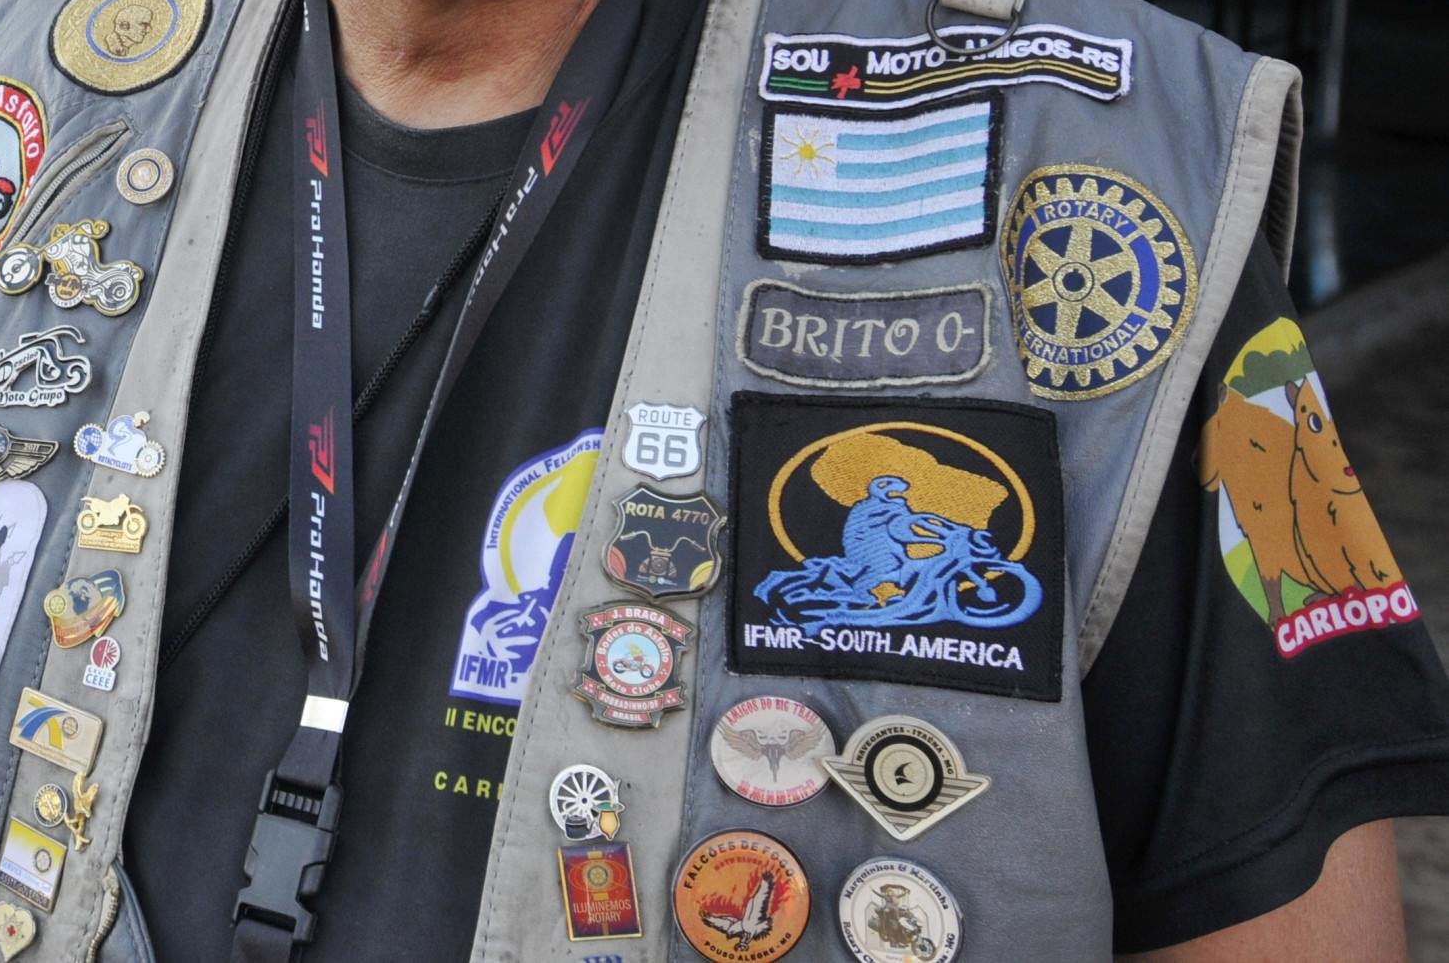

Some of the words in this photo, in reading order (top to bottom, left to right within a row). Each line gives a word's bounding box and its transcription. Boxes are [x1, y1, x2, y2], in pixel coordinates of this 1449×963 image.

[773, 48, 830, 73] SOU
[865, 46, 947, 76] MOTO
[1044, 201, 1129, 231] ROTARY
[759, 307, 920, 364] BRITO
[29, 389, 63, 405] Grupo
[638, 409, 693, 426] ROUTE
[544, 439, 601, 473] FELLOWSH
[636, 432, 688, 468] 66
[625, 501, 665, 520] ROTA
[671, 508, 710, 526] 4770
[612, 609, 623, 619] J.
[625, 608, 666, 625] BRAGA
[1277, 585, 1418, 654] CARLÓPO
[597, 624, 625, 655] Bodes
[627, 624, 642, 633] do
[645, 627, 670, 663] Asfalto
[901, 635, 1024, 671] AMERICA
[85, 673, 111, 689] CEEE
[603, 674, 627, 693] Moto
[632, 679, 663, 694] Clube
[462, 710, 517, 738] ENCO
[612, 711, 643, 722] BRASIL
[725, 699, 759, 726] AMIGOS
[792, 703, 819, 727] TRAIL
[856, 726, 905, 762] NAVEGANTES
[683, 840, 737, 890] FALCÕES
[741, 840, 759, 851] DE
[761, 845, 796, 878] FOGO
[844, 864, 895, 900] Marquinhos
[573, 898, 632, 915] ILUMINEMOS
[588, 911, 622, 926] ROTARY
[704, 940, 735, 960] POUSO
[738, 947, 775, 962] ALEGRE
[780, 932, 792, 946] MG
